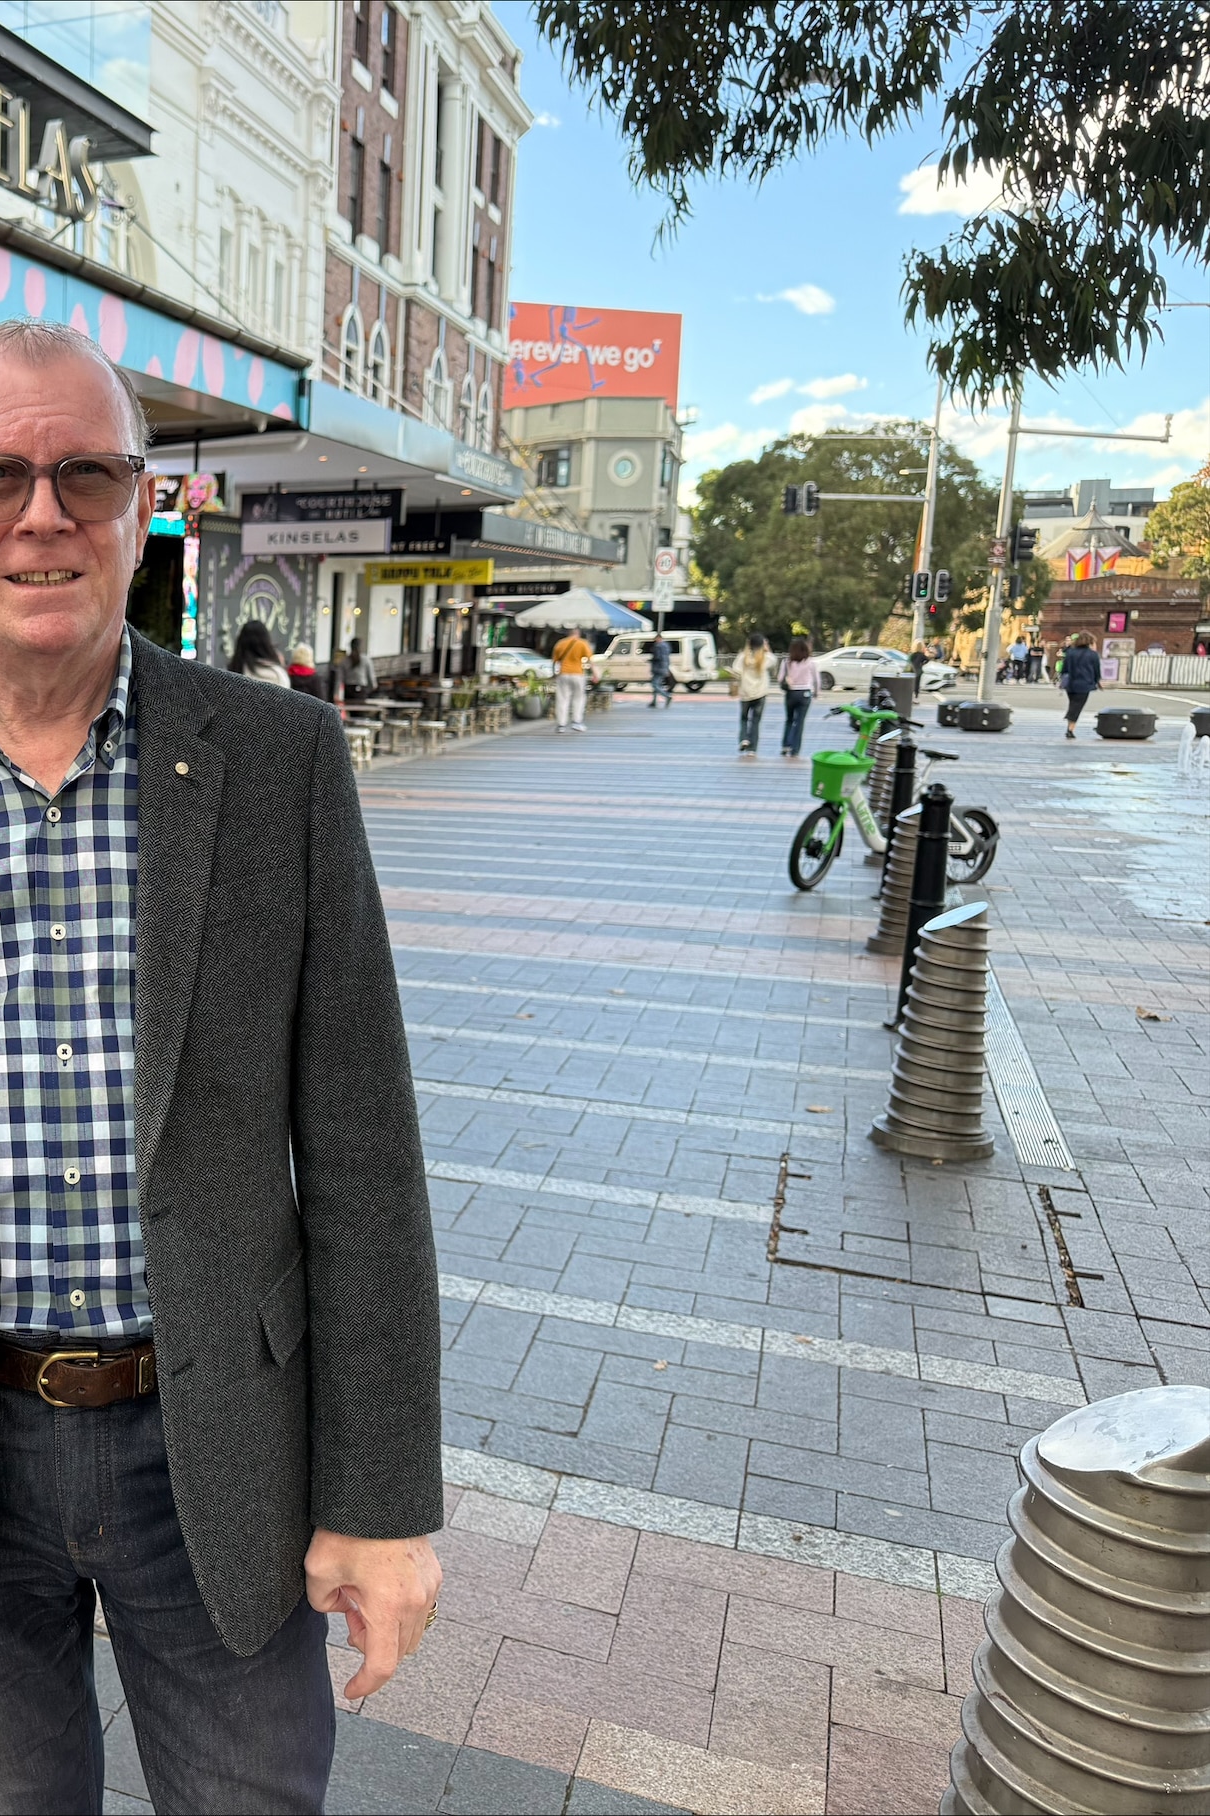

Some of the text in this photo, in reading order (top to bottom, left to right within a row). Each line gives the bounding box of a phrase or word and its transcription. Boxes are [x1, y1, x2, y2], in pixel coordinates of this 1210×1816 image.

[508, 338, 655, 373] erever we go
[267, 530, 359, 545] KINSELAS
[408, 540, 436, 551] FREE
